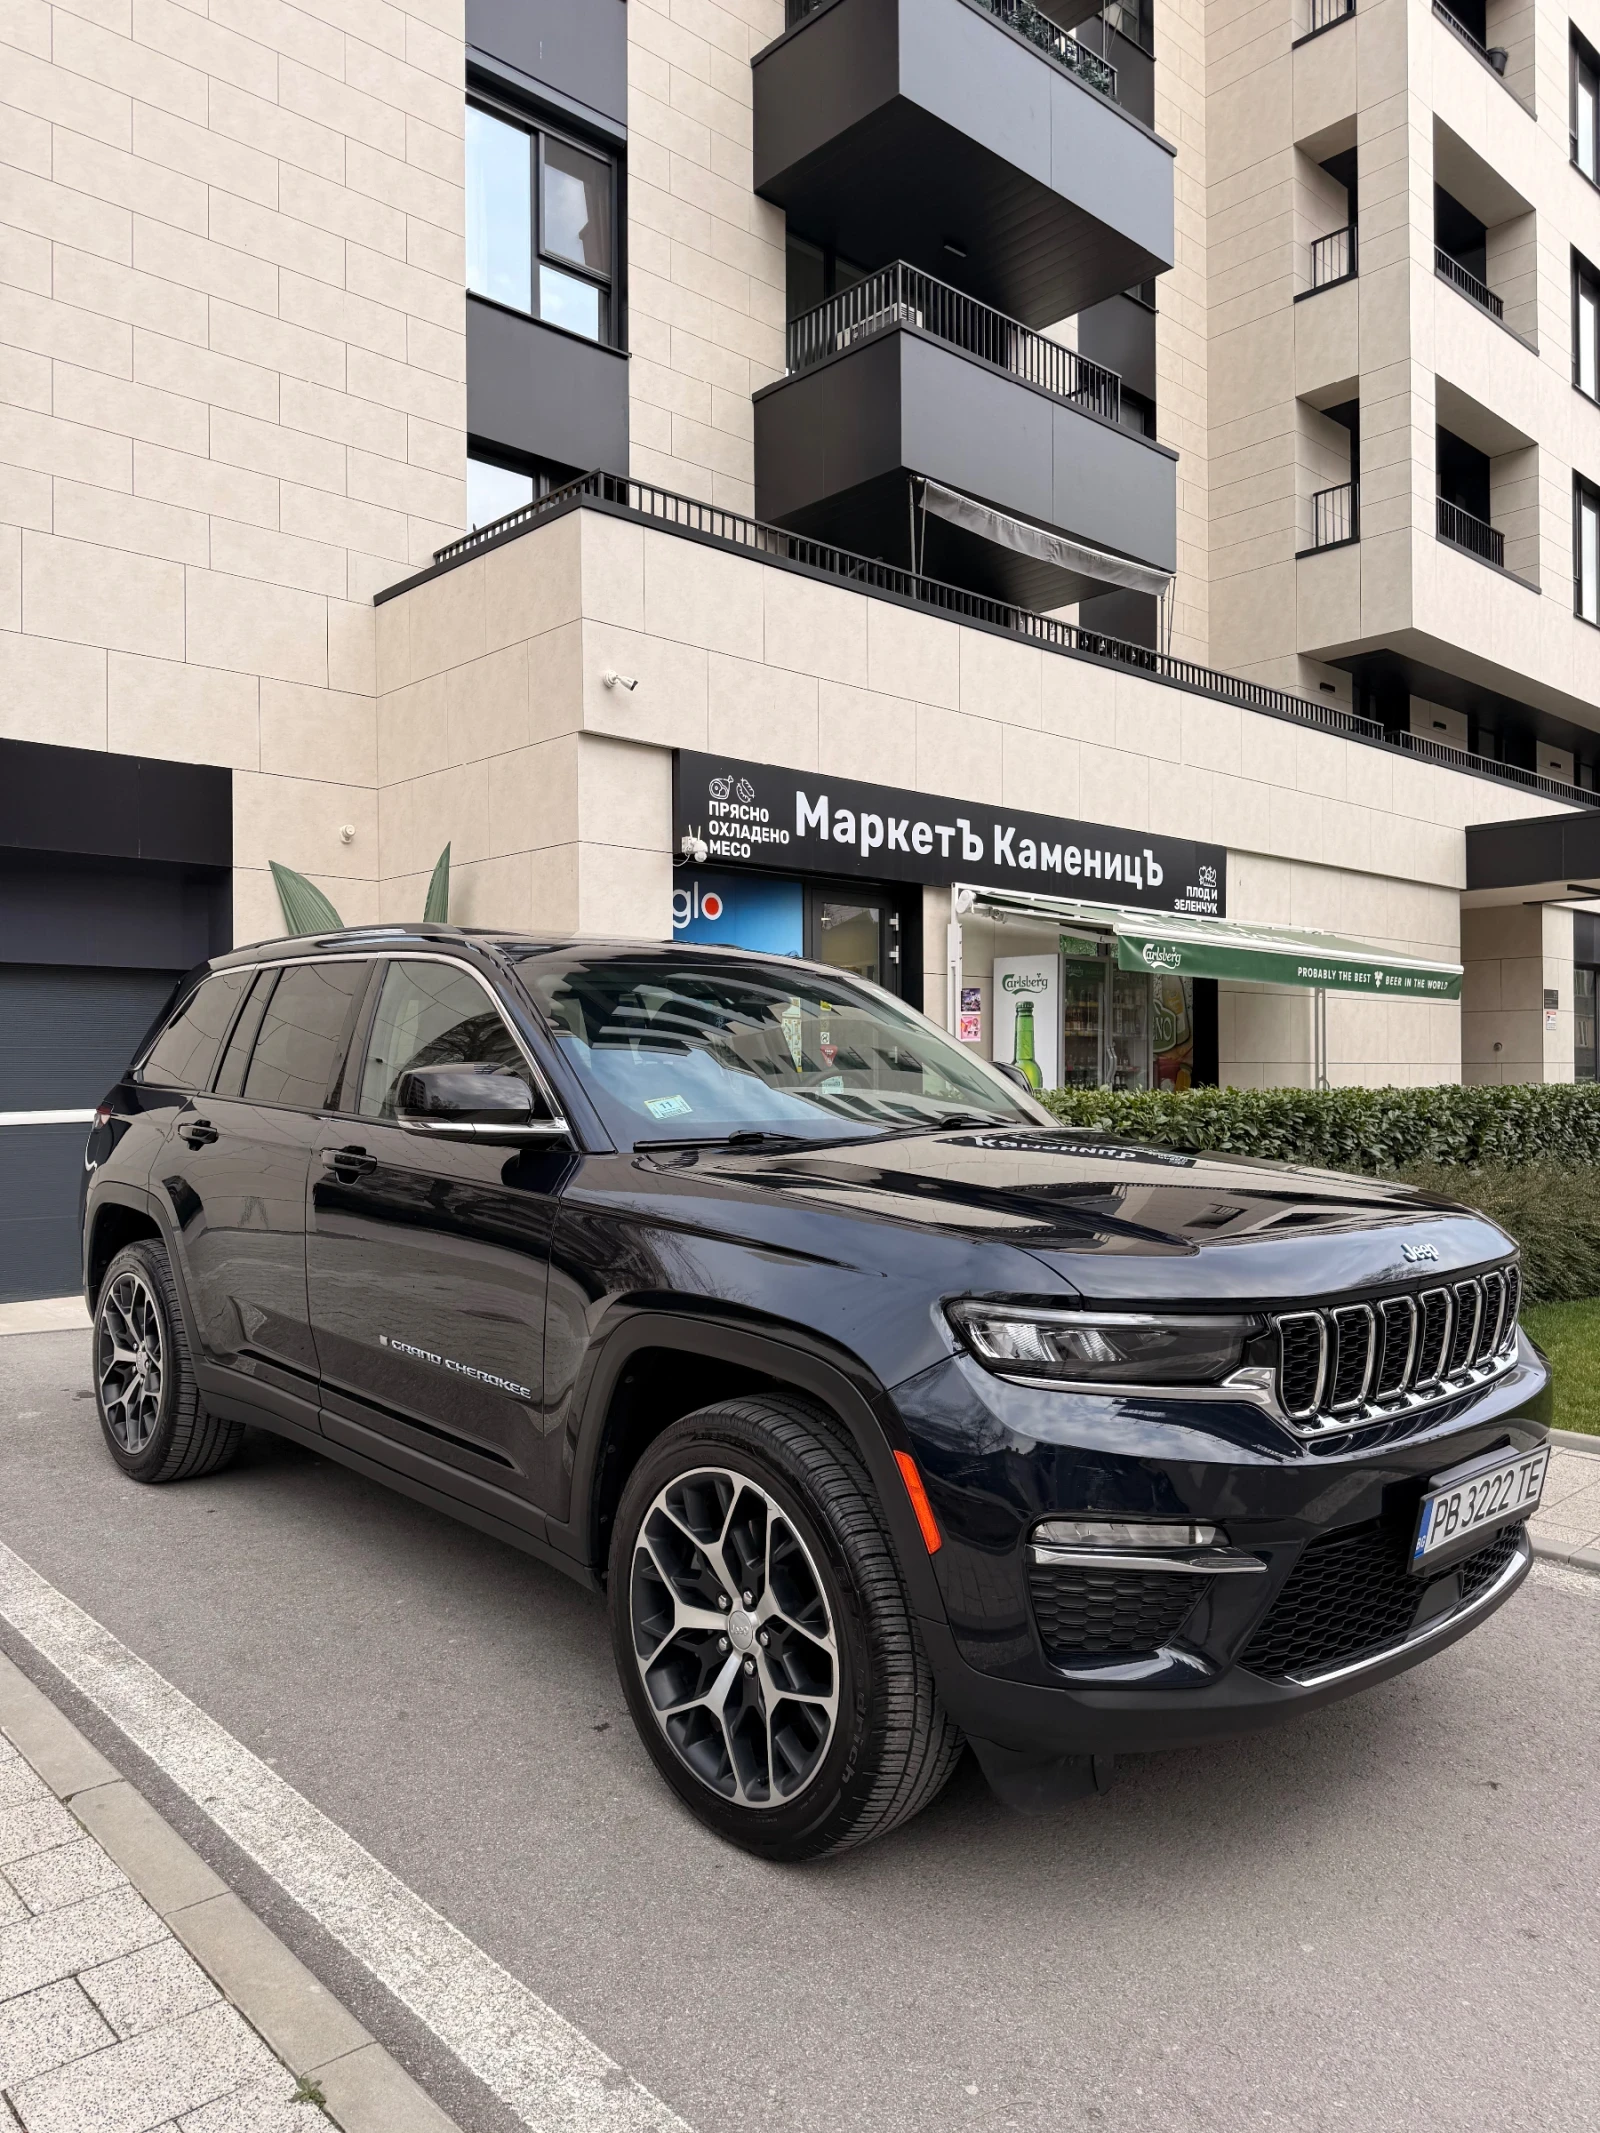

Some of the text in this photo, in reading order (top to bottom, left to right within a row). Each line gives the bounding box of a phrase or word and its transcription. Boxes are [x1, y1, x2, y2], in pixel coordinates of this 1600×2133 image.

[708, 800, 770, 823] ПРЯСНО
[708, 820, 790, 844] ОХЛАДЕНО
[709, 839, 751, 858] МЕСО
[1186, 885, 1218, 900] ПЛОД И
[673, 881, 723, 929] glo
[1174, 898, 1218, 914] ЗЕЛЕНЧУК
[1142, 943, 1182, 967] Carlsberg
[1002, 972, 1048, 994] Carlsberg
[1297, 966, 1448, 990] PROBABLY THE BEST BEER IN THE WORLD
[1400, 1243, 1440, 1262] Jeep
[391, 1339, 532, 1399] GRAND CHEROKEE
[1430, 1457, 1544, 1545] PB 3222 TE
[1415, 1534, 1427, 1551] BG
